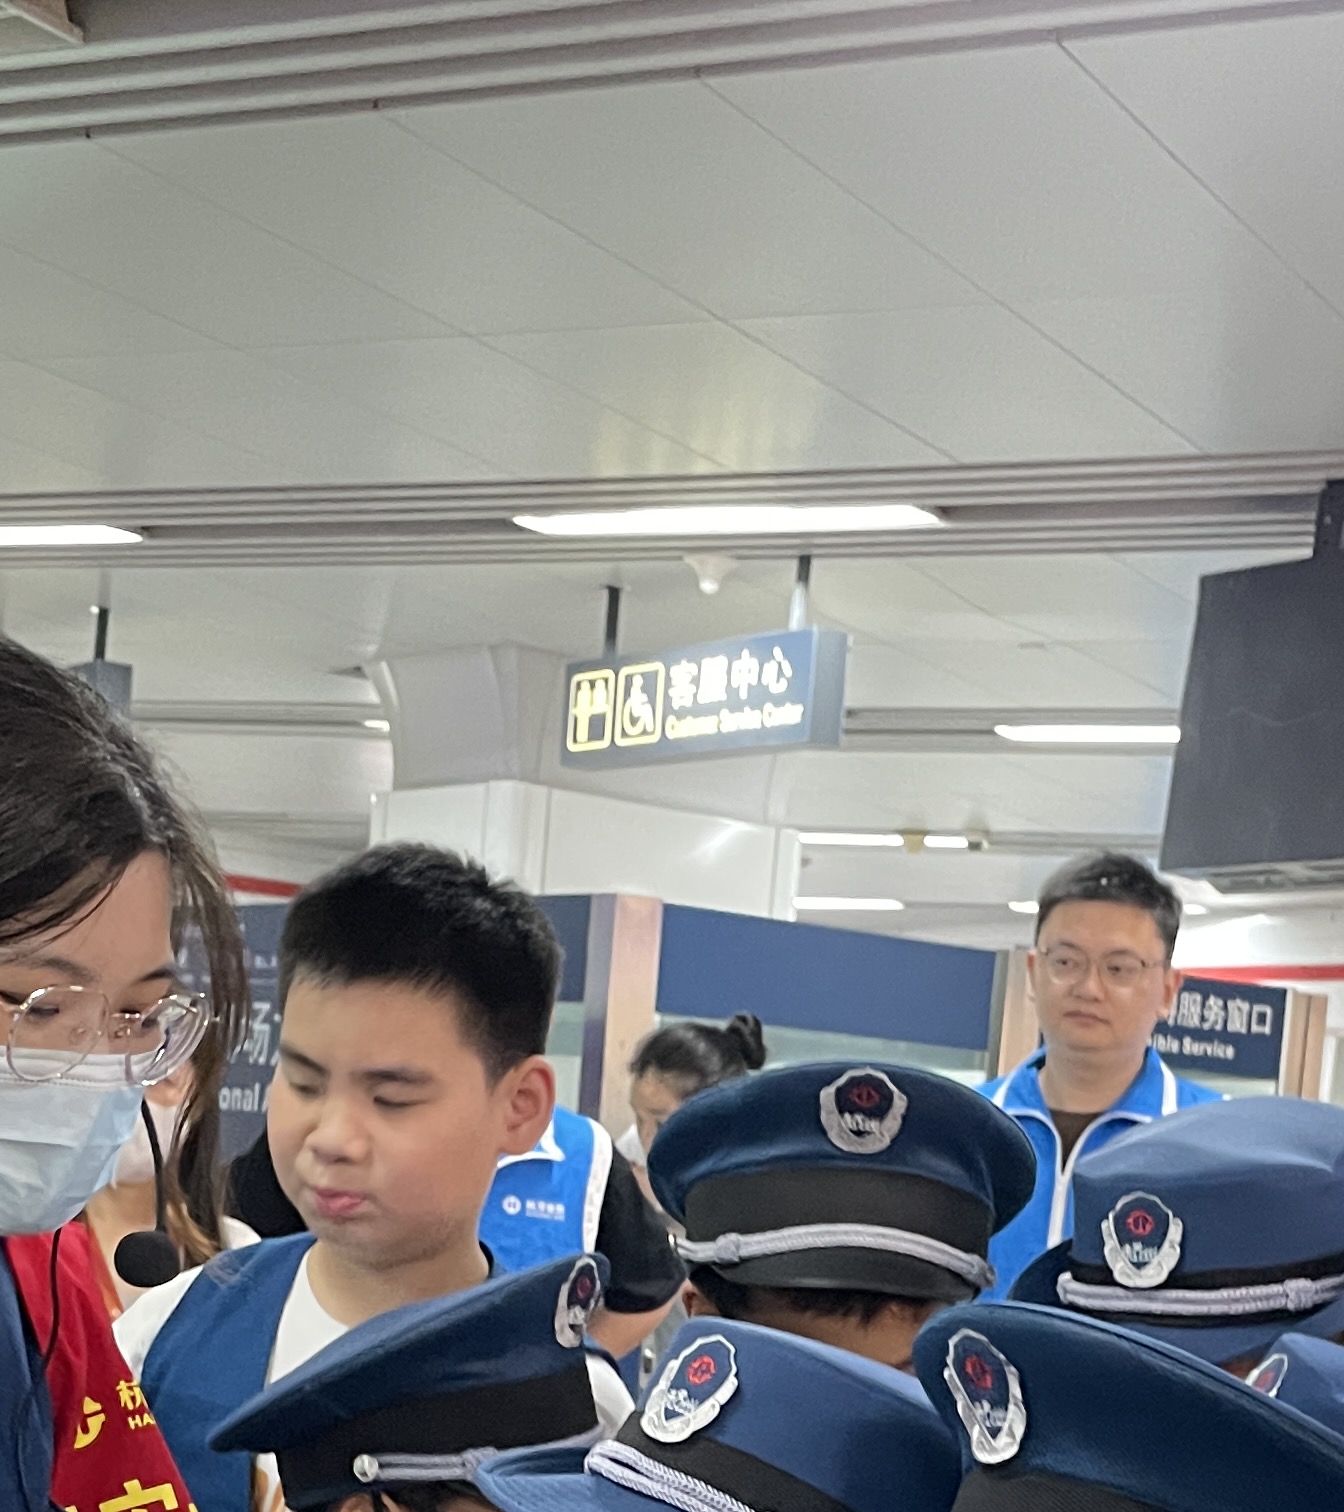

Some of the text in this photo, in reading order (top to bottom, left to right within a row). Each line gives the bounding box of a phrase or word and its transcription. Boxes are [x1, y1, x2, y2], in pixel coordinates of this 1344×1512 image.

[667, 646, 793, 710] 客服中心
[1167, 991, 1273, 1036] 服务窗口
